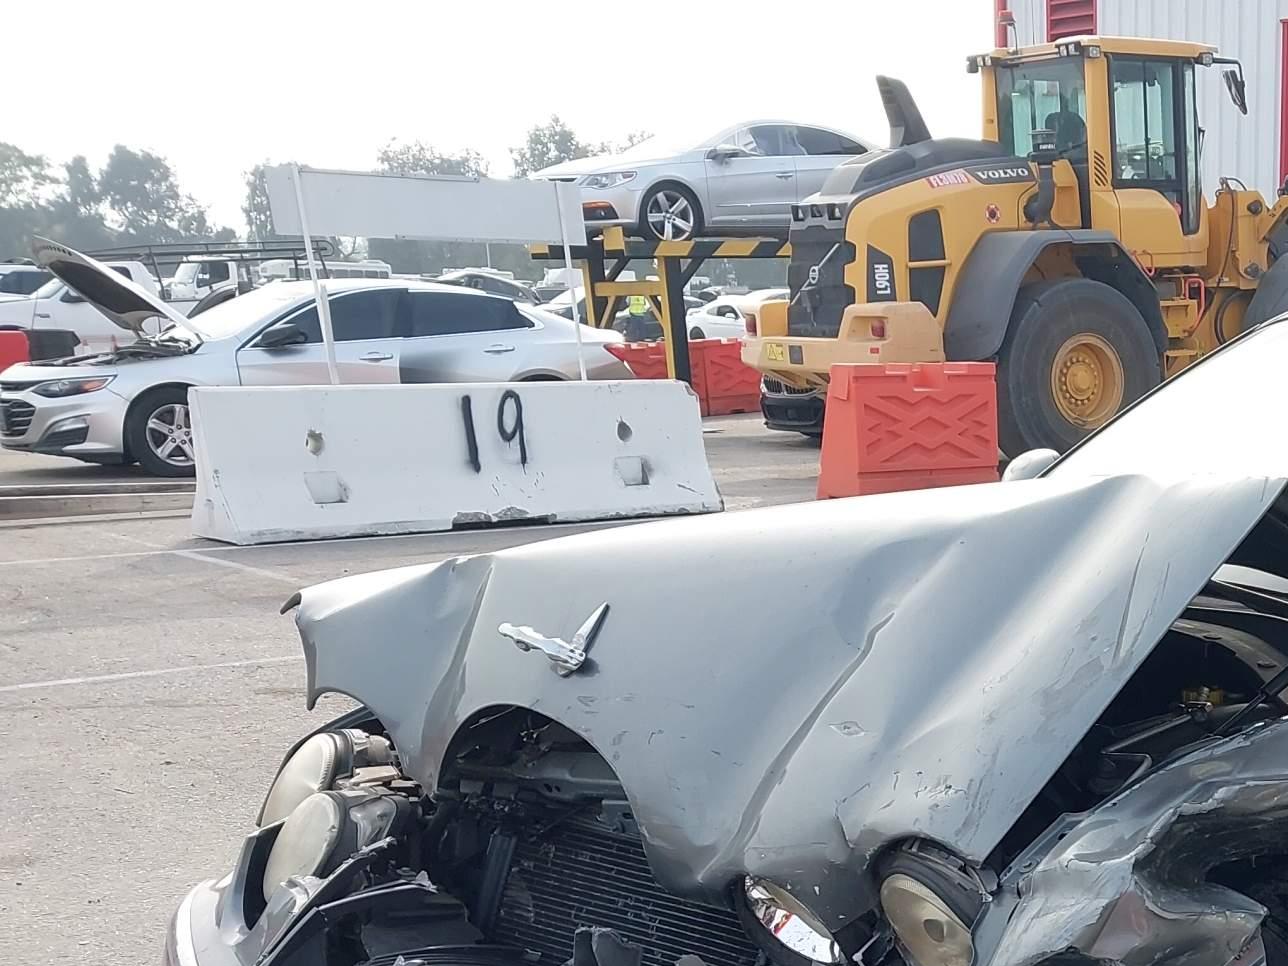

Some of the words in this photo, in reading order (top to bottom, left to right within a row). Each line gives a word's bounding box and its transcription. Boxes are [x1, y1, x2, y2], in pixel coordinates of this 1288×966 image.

[976, 167, 1029, 180] VOLVO
[873, 263, 892, 295] L90H
[460, 388, 527, 474] 19
